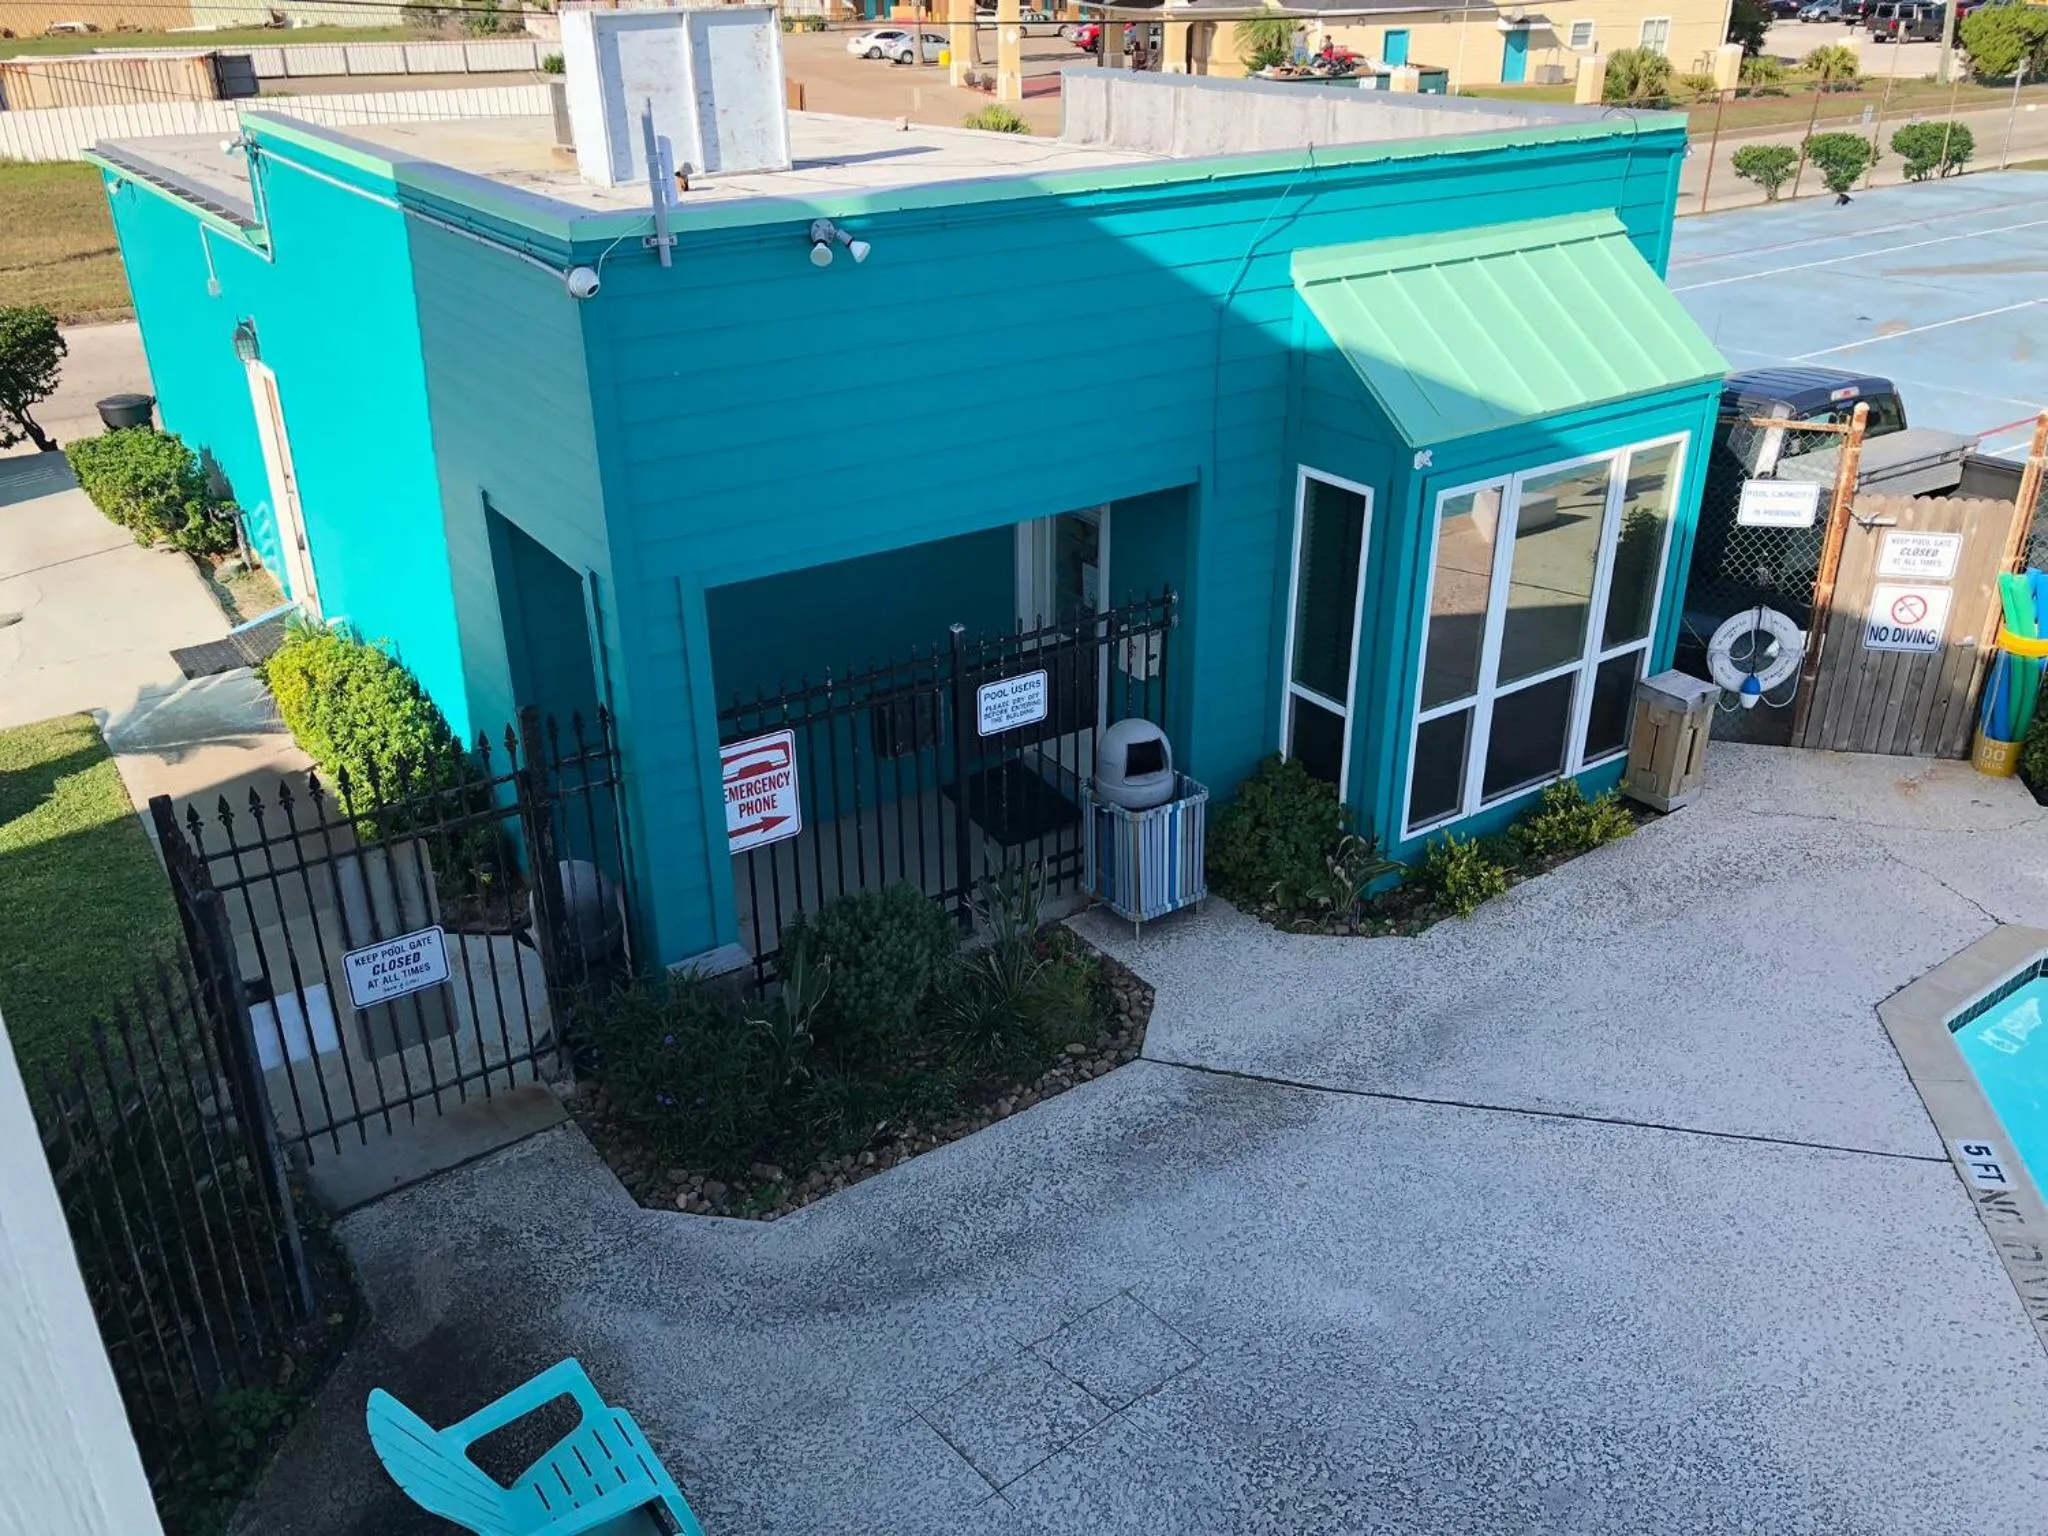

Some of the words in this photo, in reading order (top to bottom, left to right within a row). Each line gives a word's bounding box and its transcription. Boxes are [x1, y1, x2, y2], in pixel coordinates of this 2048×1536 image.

[1891, 537, 1911, 545] KEEP
[1911, 538, 1931, 546] POOL
[1933, 539, 1952, 547] GATE
[1899, 546, 1940, 558] CLOSED
[1892, 557, 1901, 565] AT
[1903, 558, 1917, 566] ALL
[1920, 559, 1942, 567] TIMES
[1868, 625, 1889, 642] NO
[1892, 627, 1937, 645] DIVING
[984, 689, 1009, 702] POOL
[1011, 680, 1041, 694] USERS
[983, 708, 1008, 720] BEFORE
[1011, 699, 1041, 712] ENTERING
[985, 700, 1009, 712] PLEASE
[1012, 697, 1025, 705] DRY
[1028, 692, 1040, 701] OFF
[991, 715, 1002, 723] THE
[724, 771, 791, 804] EMERGENCY
[738, 794, 778, 819] PHONE
[354, 952, 378, 967] KEEP
[380, 945, 407, 960] POOL
[409, 936, 433, 950] GATE
[372, 951, 421, 976] CLOSED
[367, 979, 379, 990] AT
[383, 973, 400, 985] ALL
[401, 962, 431, 978] TIMES
[1963, 1144, 1992, 1156] 5
[1971, 1162, 2006, 1184] FT
